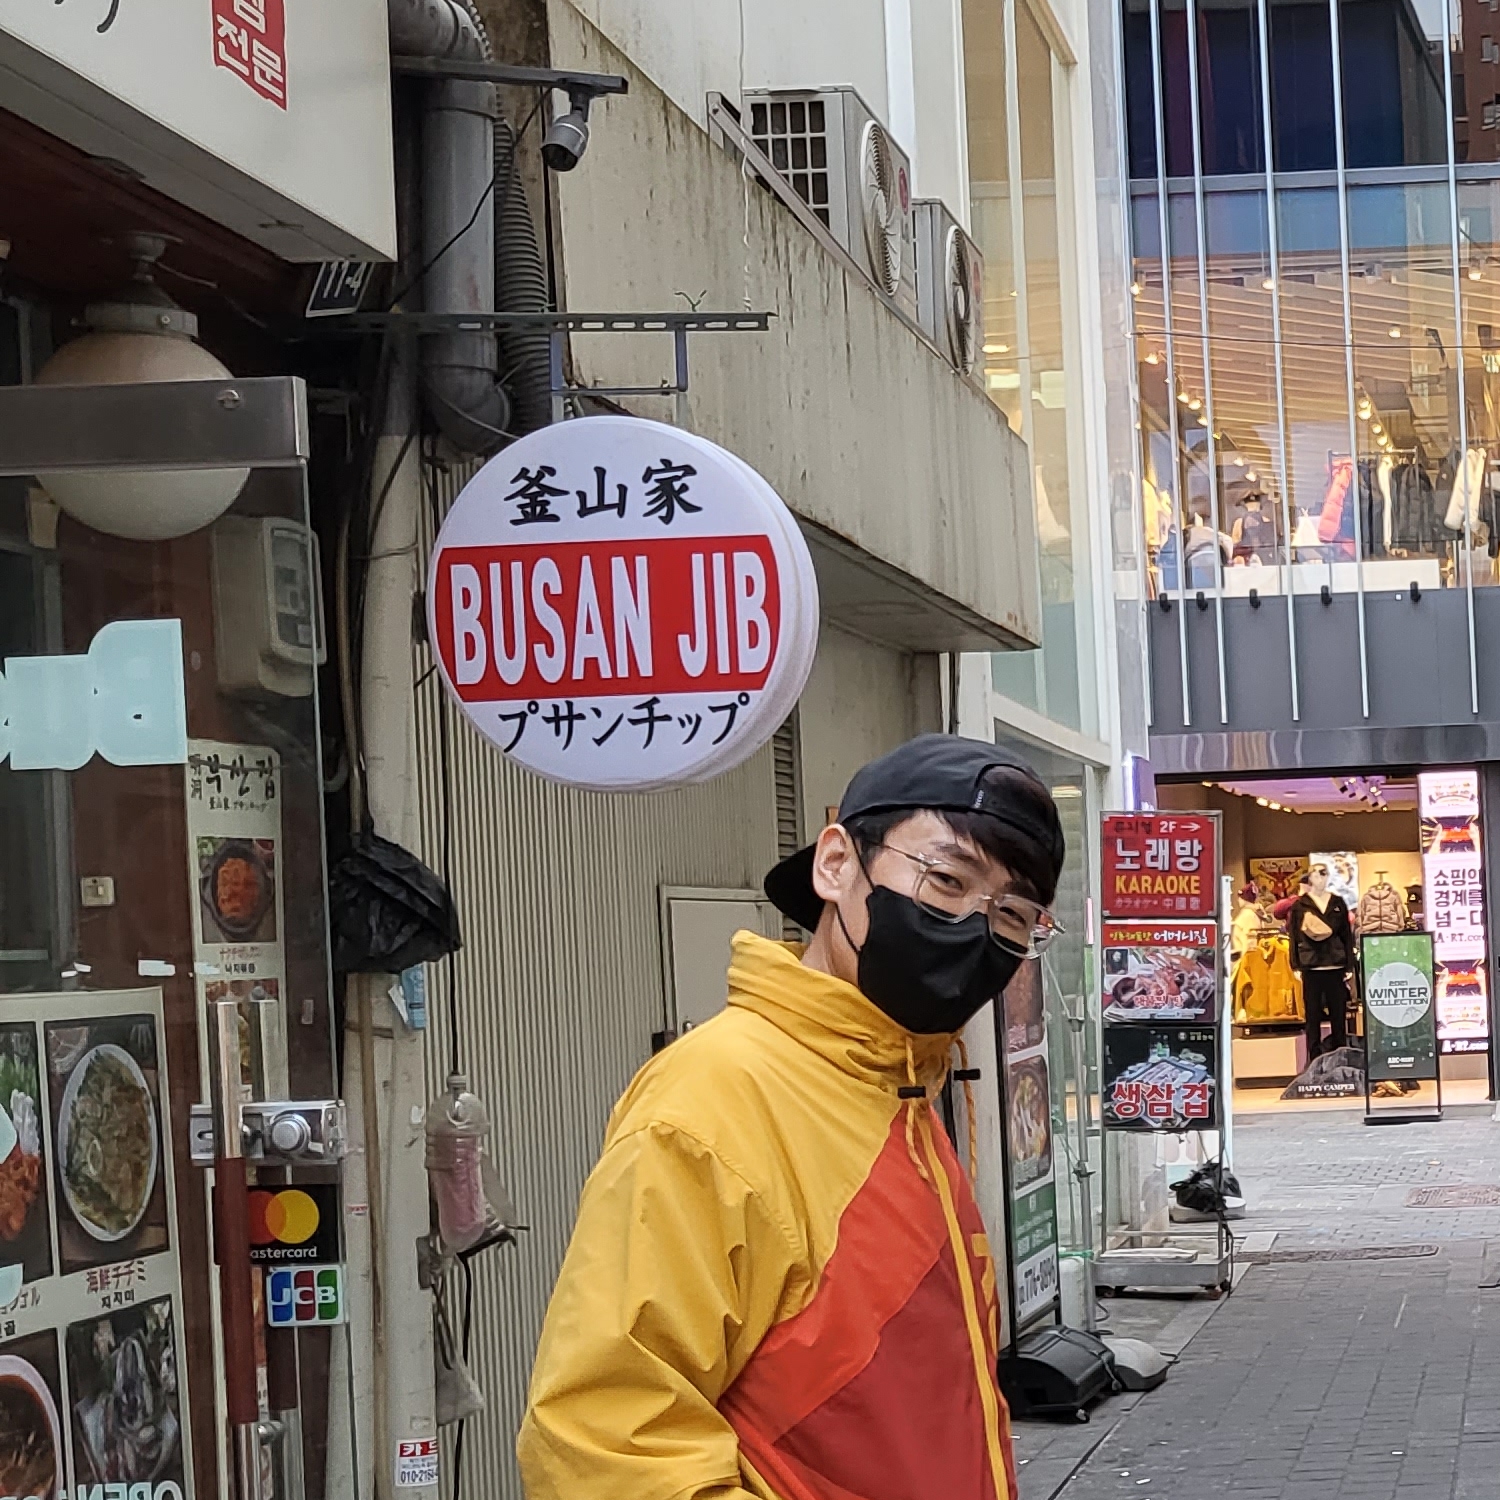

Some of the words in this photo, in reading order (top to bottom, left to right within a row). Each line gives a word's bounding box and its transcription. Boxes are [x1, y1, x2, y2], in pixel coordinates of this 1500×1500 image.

[503, 458, 703, 526] 釜山家
[450, 554, 653, 685] BUSAN
[677, 551, 771, 677] JIB
[498, 691, 751, 754] プサンチップ
[1159, 821, 1178, 833] 2F
[1115, 838, 1203, 871] 노래방
[1115, 875, 1202, 895] KARAOKE
[1153, 928, 1208, 945] 어머니집
[1368, 987, 1429, 999] WINTER
[1369, 998, 1429, 1007] COLLECTION
[1298, 1085, 1323, 1093] HAPPY
[1323, 1083, 1355, 1092] CAMPER
[1113, 1083, 1209, 1118] 생삼겹
[250, 1246, 318, 1259] astercard
[271, 1286, 337, 1306] JCB
